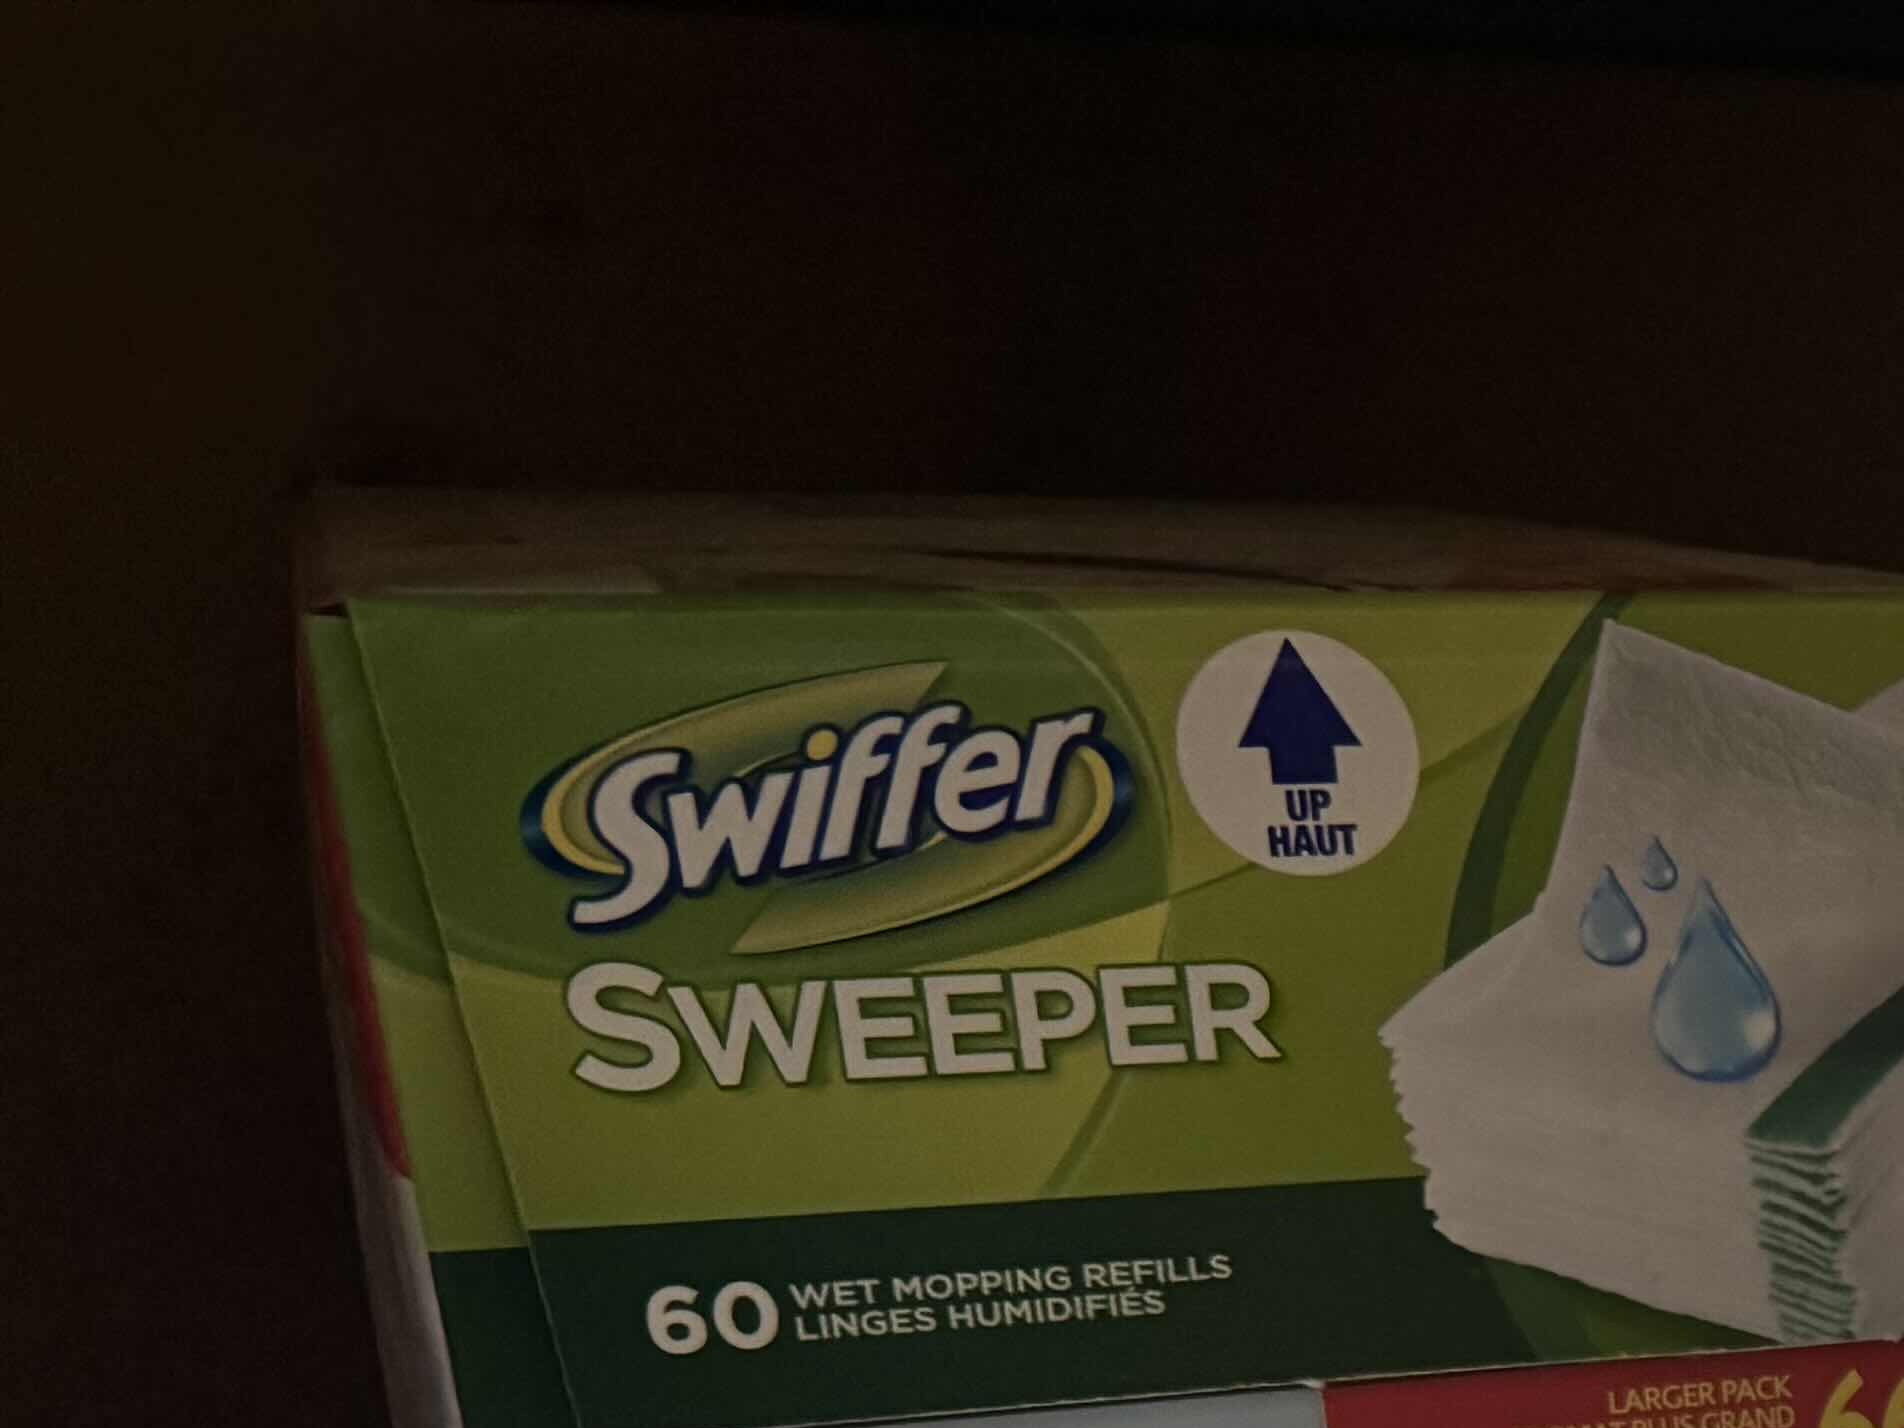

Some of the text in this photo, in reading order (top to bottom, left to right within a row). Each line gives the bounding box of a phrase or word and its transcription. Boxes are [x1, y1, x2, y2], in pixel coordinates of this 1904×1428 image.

[567, 701, 1102, 930] Swiffer
[1285, 789, 1331, 821] UP
[1268, 823, 1359, 858] HAUT
[564, 960, 1284, 1093] SWEEPER
[788, 1253, 1234, 1311] WET MOPPING REFILLS
[645, 1280, 780, 1356] 60
[796, 1286, 1166, 1343] LINGES HUMIDIFIÉS
[1608, 1374, 1794, 1415] LARGER PACK
